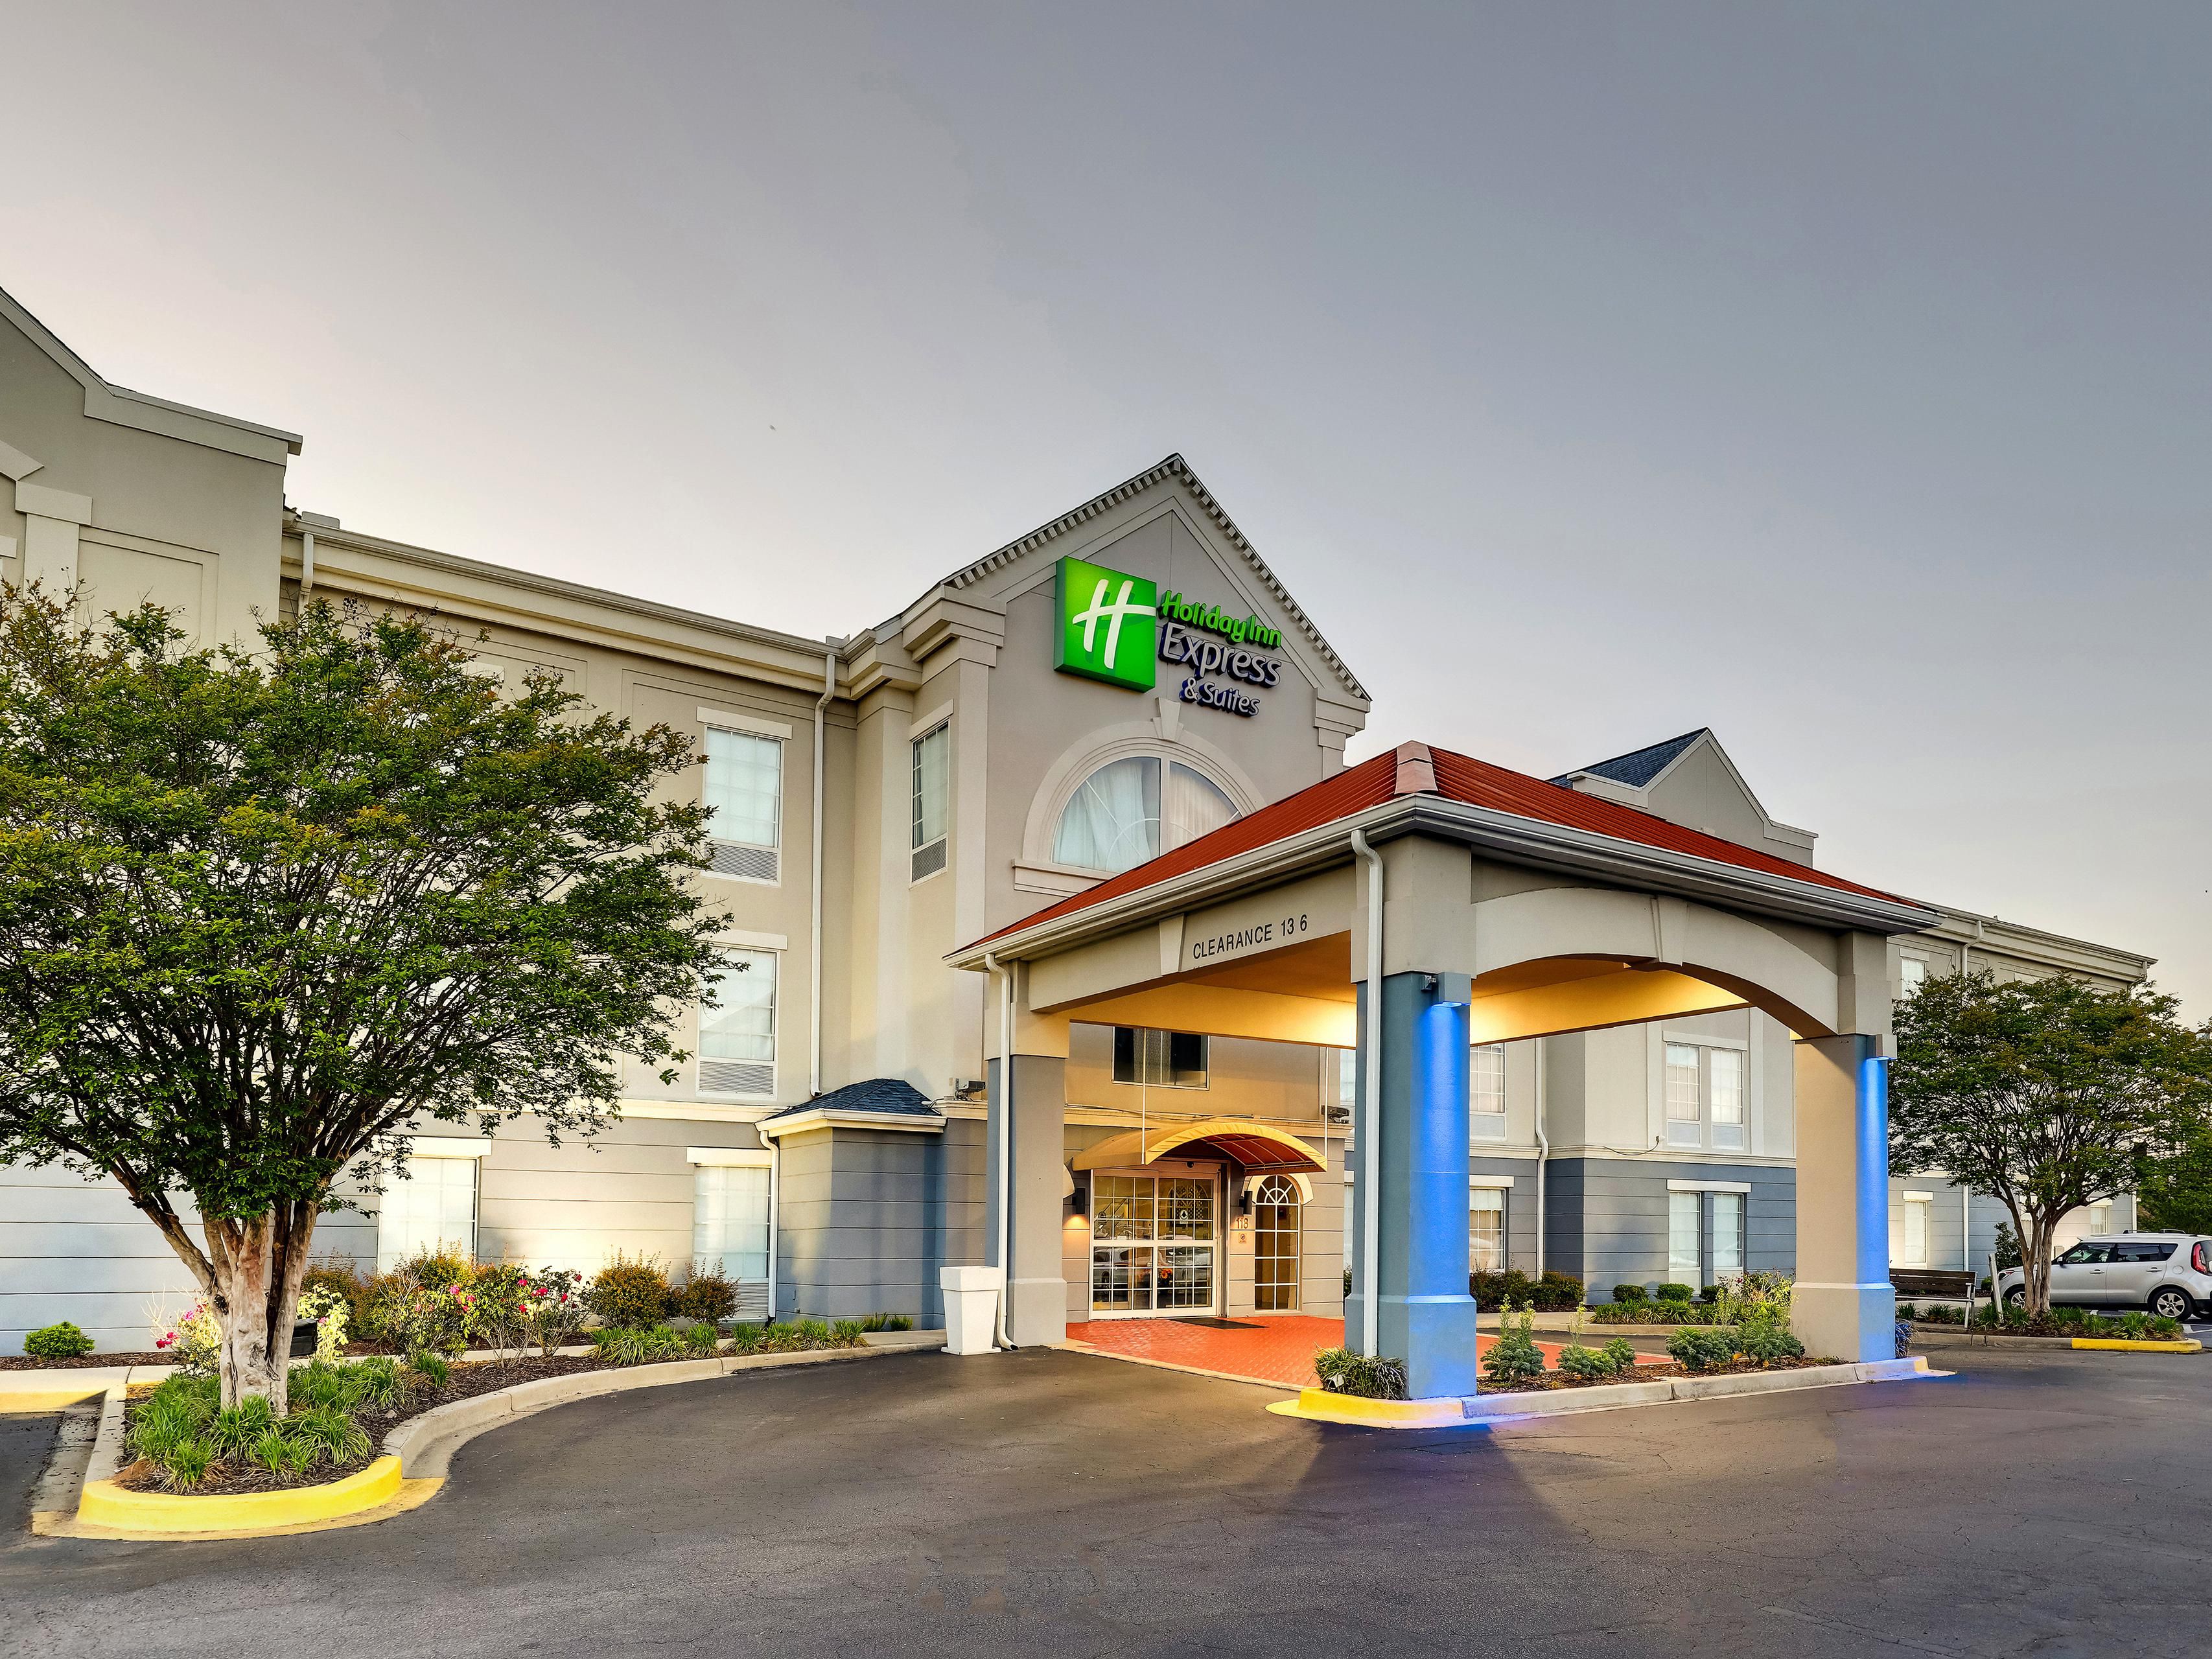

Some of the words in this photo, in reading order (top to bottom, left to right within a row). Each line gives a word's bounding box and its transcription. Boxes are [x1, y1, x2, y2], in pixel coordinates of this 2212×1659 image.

[1073, 579, 1156, 669] H
[1161, 590, 1246, 643] Holiday
[1249, 614, 1282, 647] Inn
[1163, 621, 1282, 686] Express
[1184, 677, 1199, 701] &
[1202, 681, 1261, 716] Suites
[1193, 923, 1272, 960] CLEARANCE
[1236, 1217, 1249, 1229] 118
